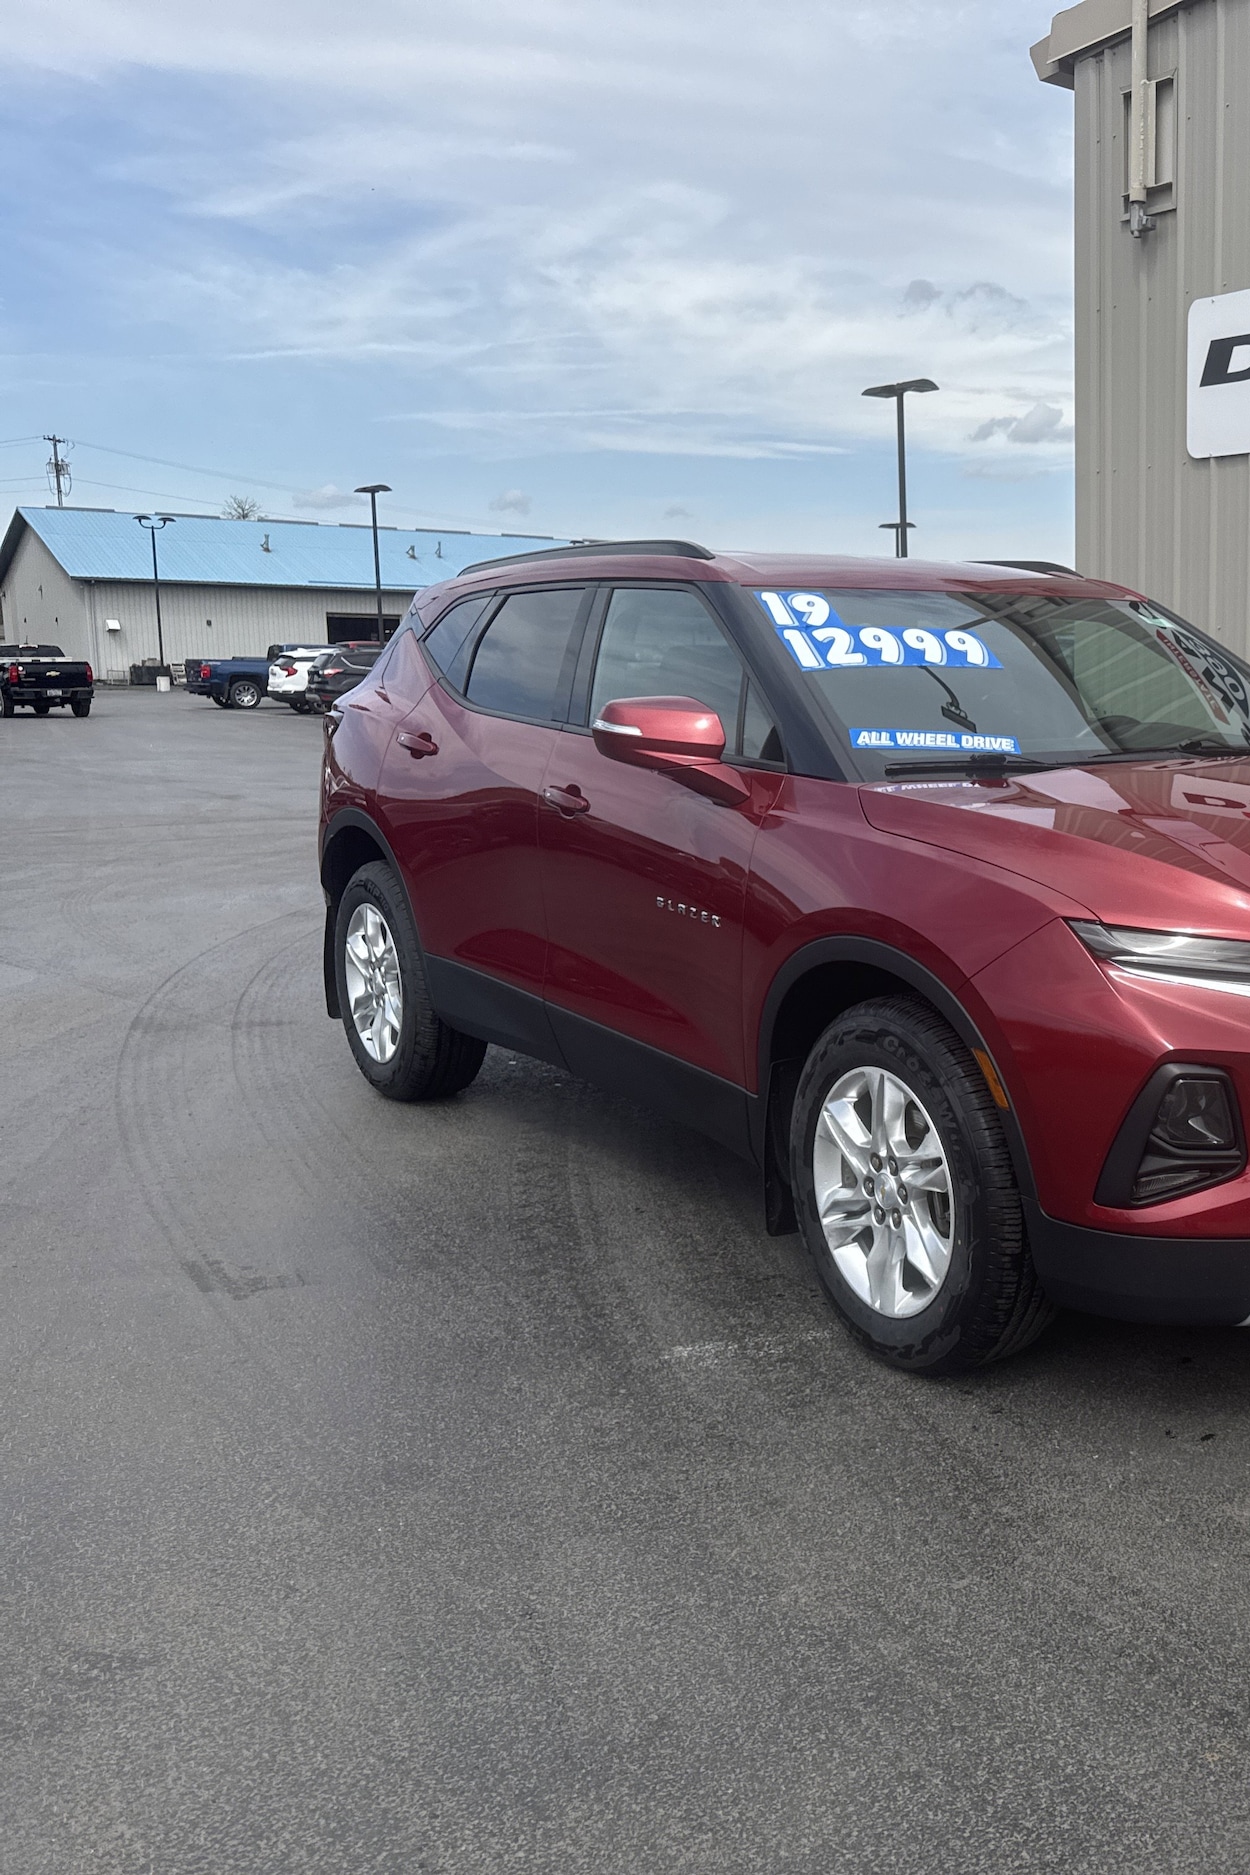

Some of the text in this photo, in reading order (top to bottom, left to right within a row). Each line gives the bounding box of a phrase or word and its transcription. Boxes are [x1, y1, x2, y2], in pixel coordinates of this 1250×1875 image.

[761, 591, 830, 627] 19
[783, 627, 989, 669] 12999
[856, 731, 1015, 752] ALL WHEEL DRIVE
[656, 896, 722, 928] BLAZER
